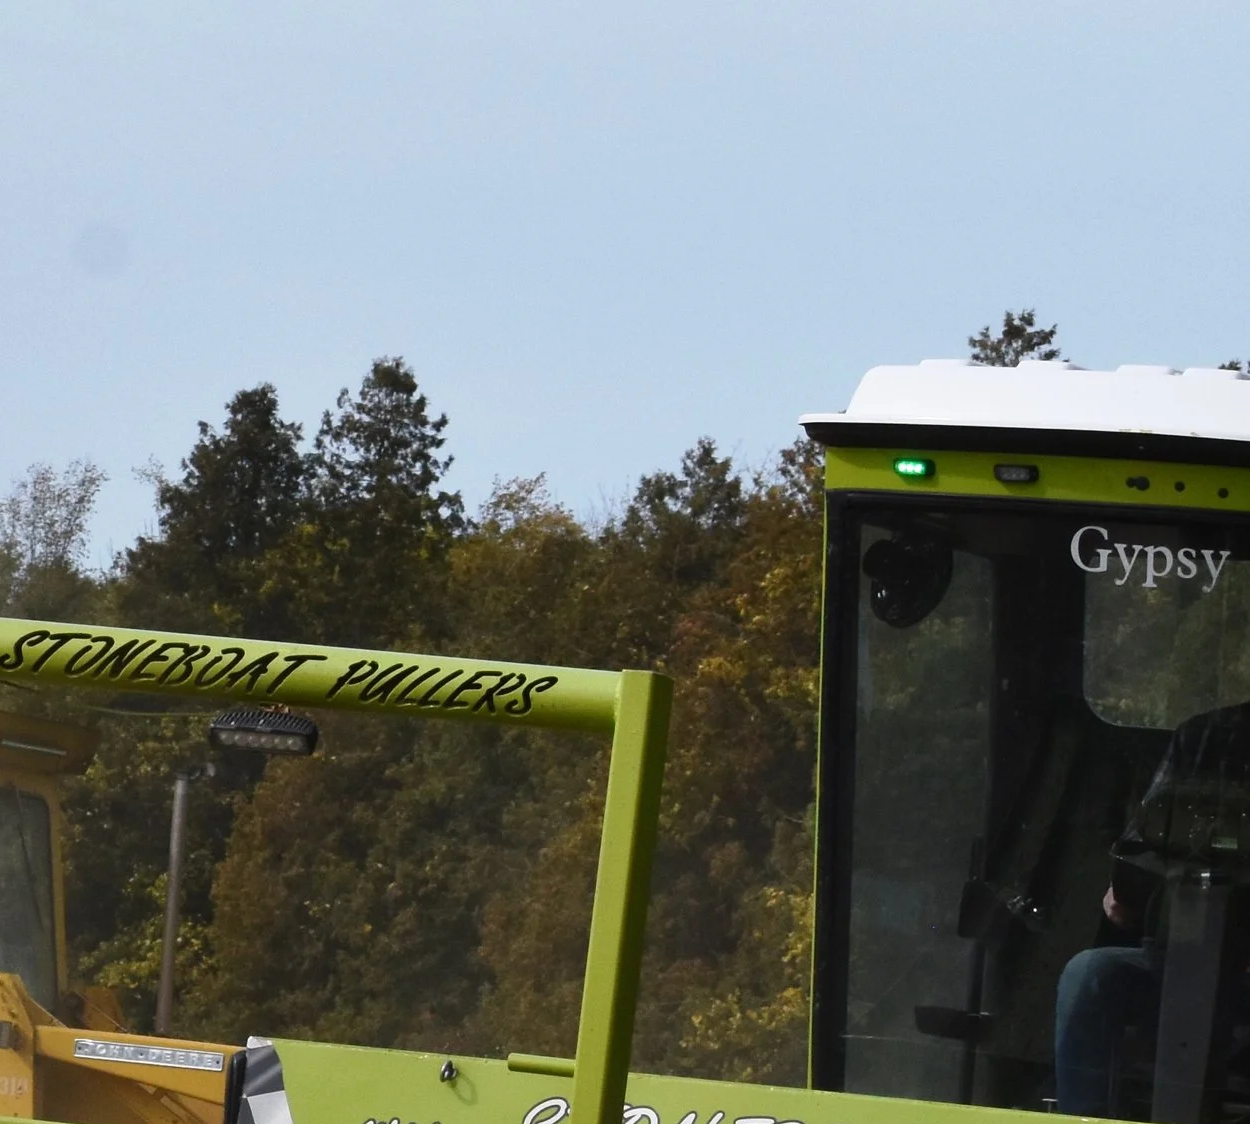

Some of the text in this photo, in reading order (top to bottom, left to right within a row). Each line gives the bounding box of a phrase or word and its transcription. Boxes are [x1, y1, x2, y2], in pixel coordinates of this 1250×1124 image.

[1070, 526, 1232, 593] Gypsy
[325, 659, 559, 717] PULLERS
[82, 1043, 214, 1066] JOHN DEERE
